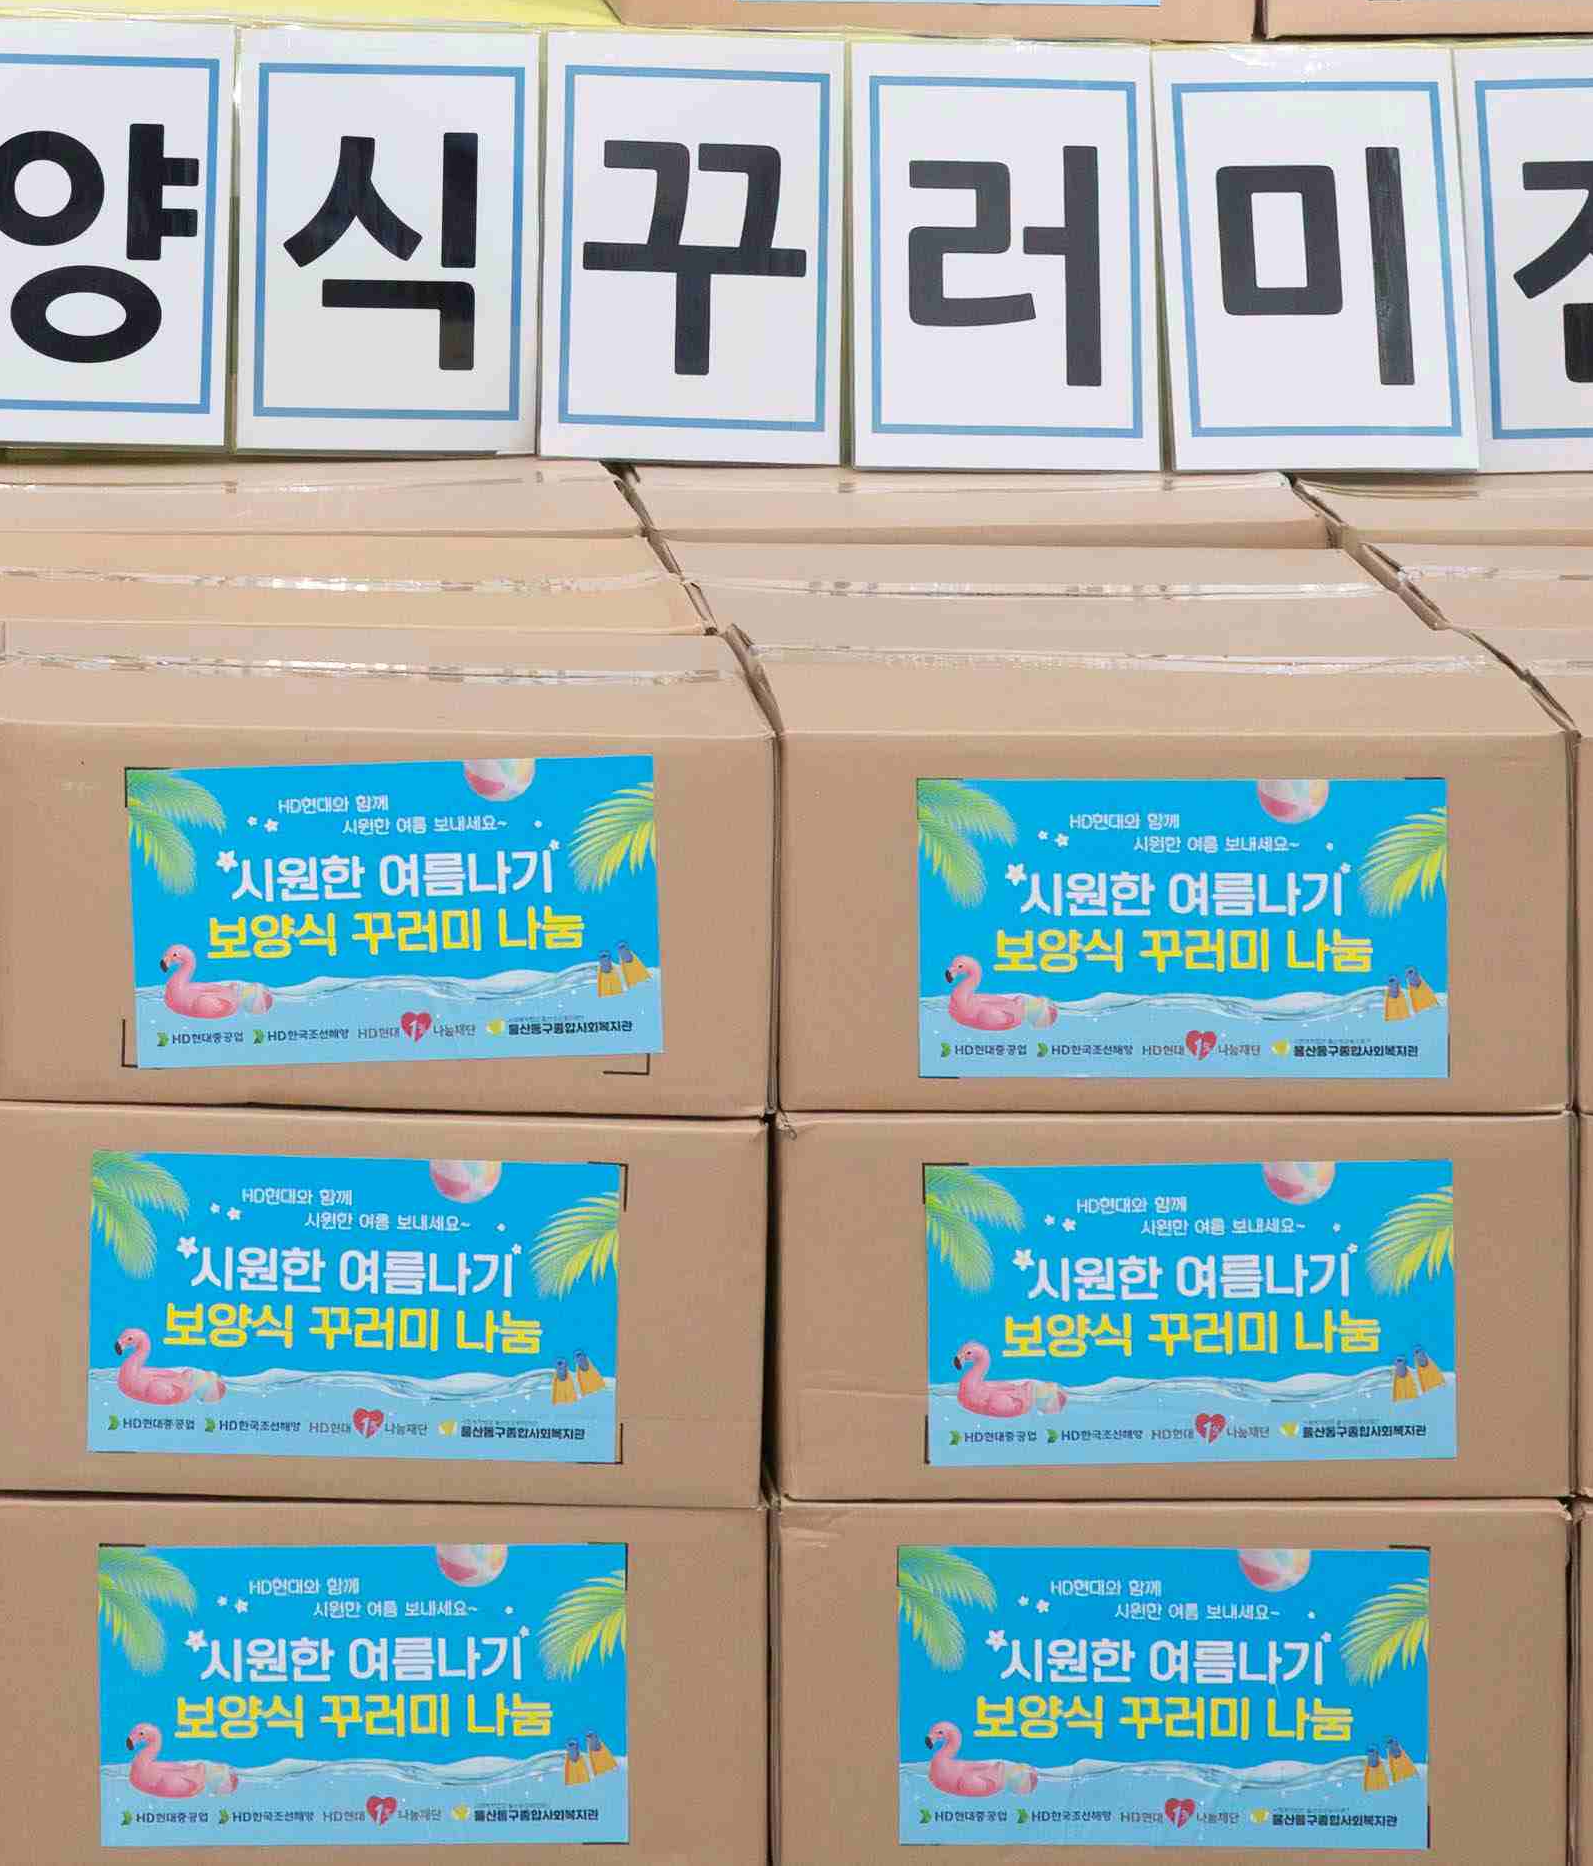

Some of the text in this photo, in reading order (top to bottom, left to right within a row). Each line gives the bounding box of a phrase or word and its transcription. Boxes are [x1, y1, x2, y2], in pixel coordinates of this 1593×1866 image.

[999, 1637, 1325, 1685] 시원한 여름나기
[974, 1695, 1355, 1742] 보양식 꾸러미 나눔
